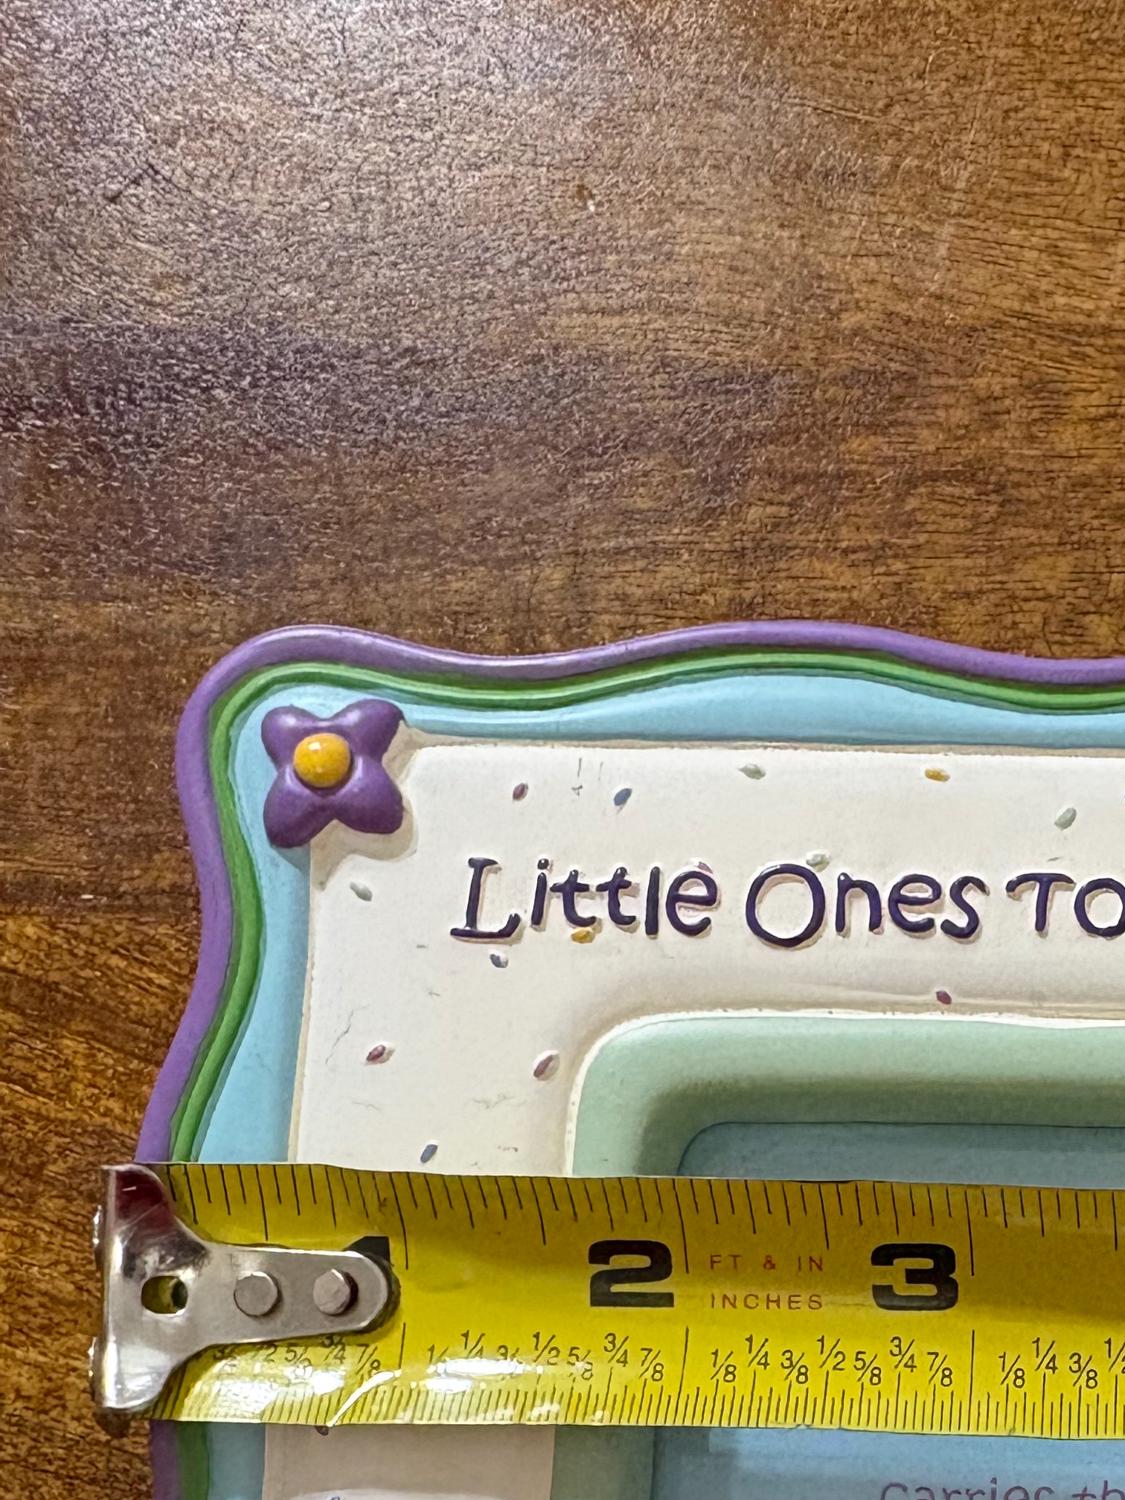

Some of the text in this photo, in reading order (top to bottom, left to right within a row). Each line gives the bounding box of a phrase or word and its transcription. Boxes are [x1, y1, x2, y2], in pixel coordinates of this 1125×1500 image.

[449, 857, 722, 941] Little
[744, 863, 990, 948] Ones
[587, 1239, 674, 1308] 2
[870, 1243, 959, 1311] 3
[710, 1255, 823, 1271] FT & IN
[711, 1293, 822, 1310] INCHES
[532, 1332, 560, 1365] 1/2
[604, 1333, 629, 1367] 3/4
[639, 1348, 664, 1382] 7/8
[711, 1348, 737, 1382] 1/8
[745, 1334, 770, 1371] 1/4
[781, 1349, 809, 1384] 3/8
[816, 1335, 846, 1371] 1/2
[853, 1350, 881, 1385] 5/8
[889, 1336, 917, 1372] 3/4
[927, 1352, 953, 1387] 7/8
[998, 1352, 1025, 1388] 1/8
[1032, 1337, 1058, 1374] 1/4
[1069, 1352, 1098, 1389] 3/8
